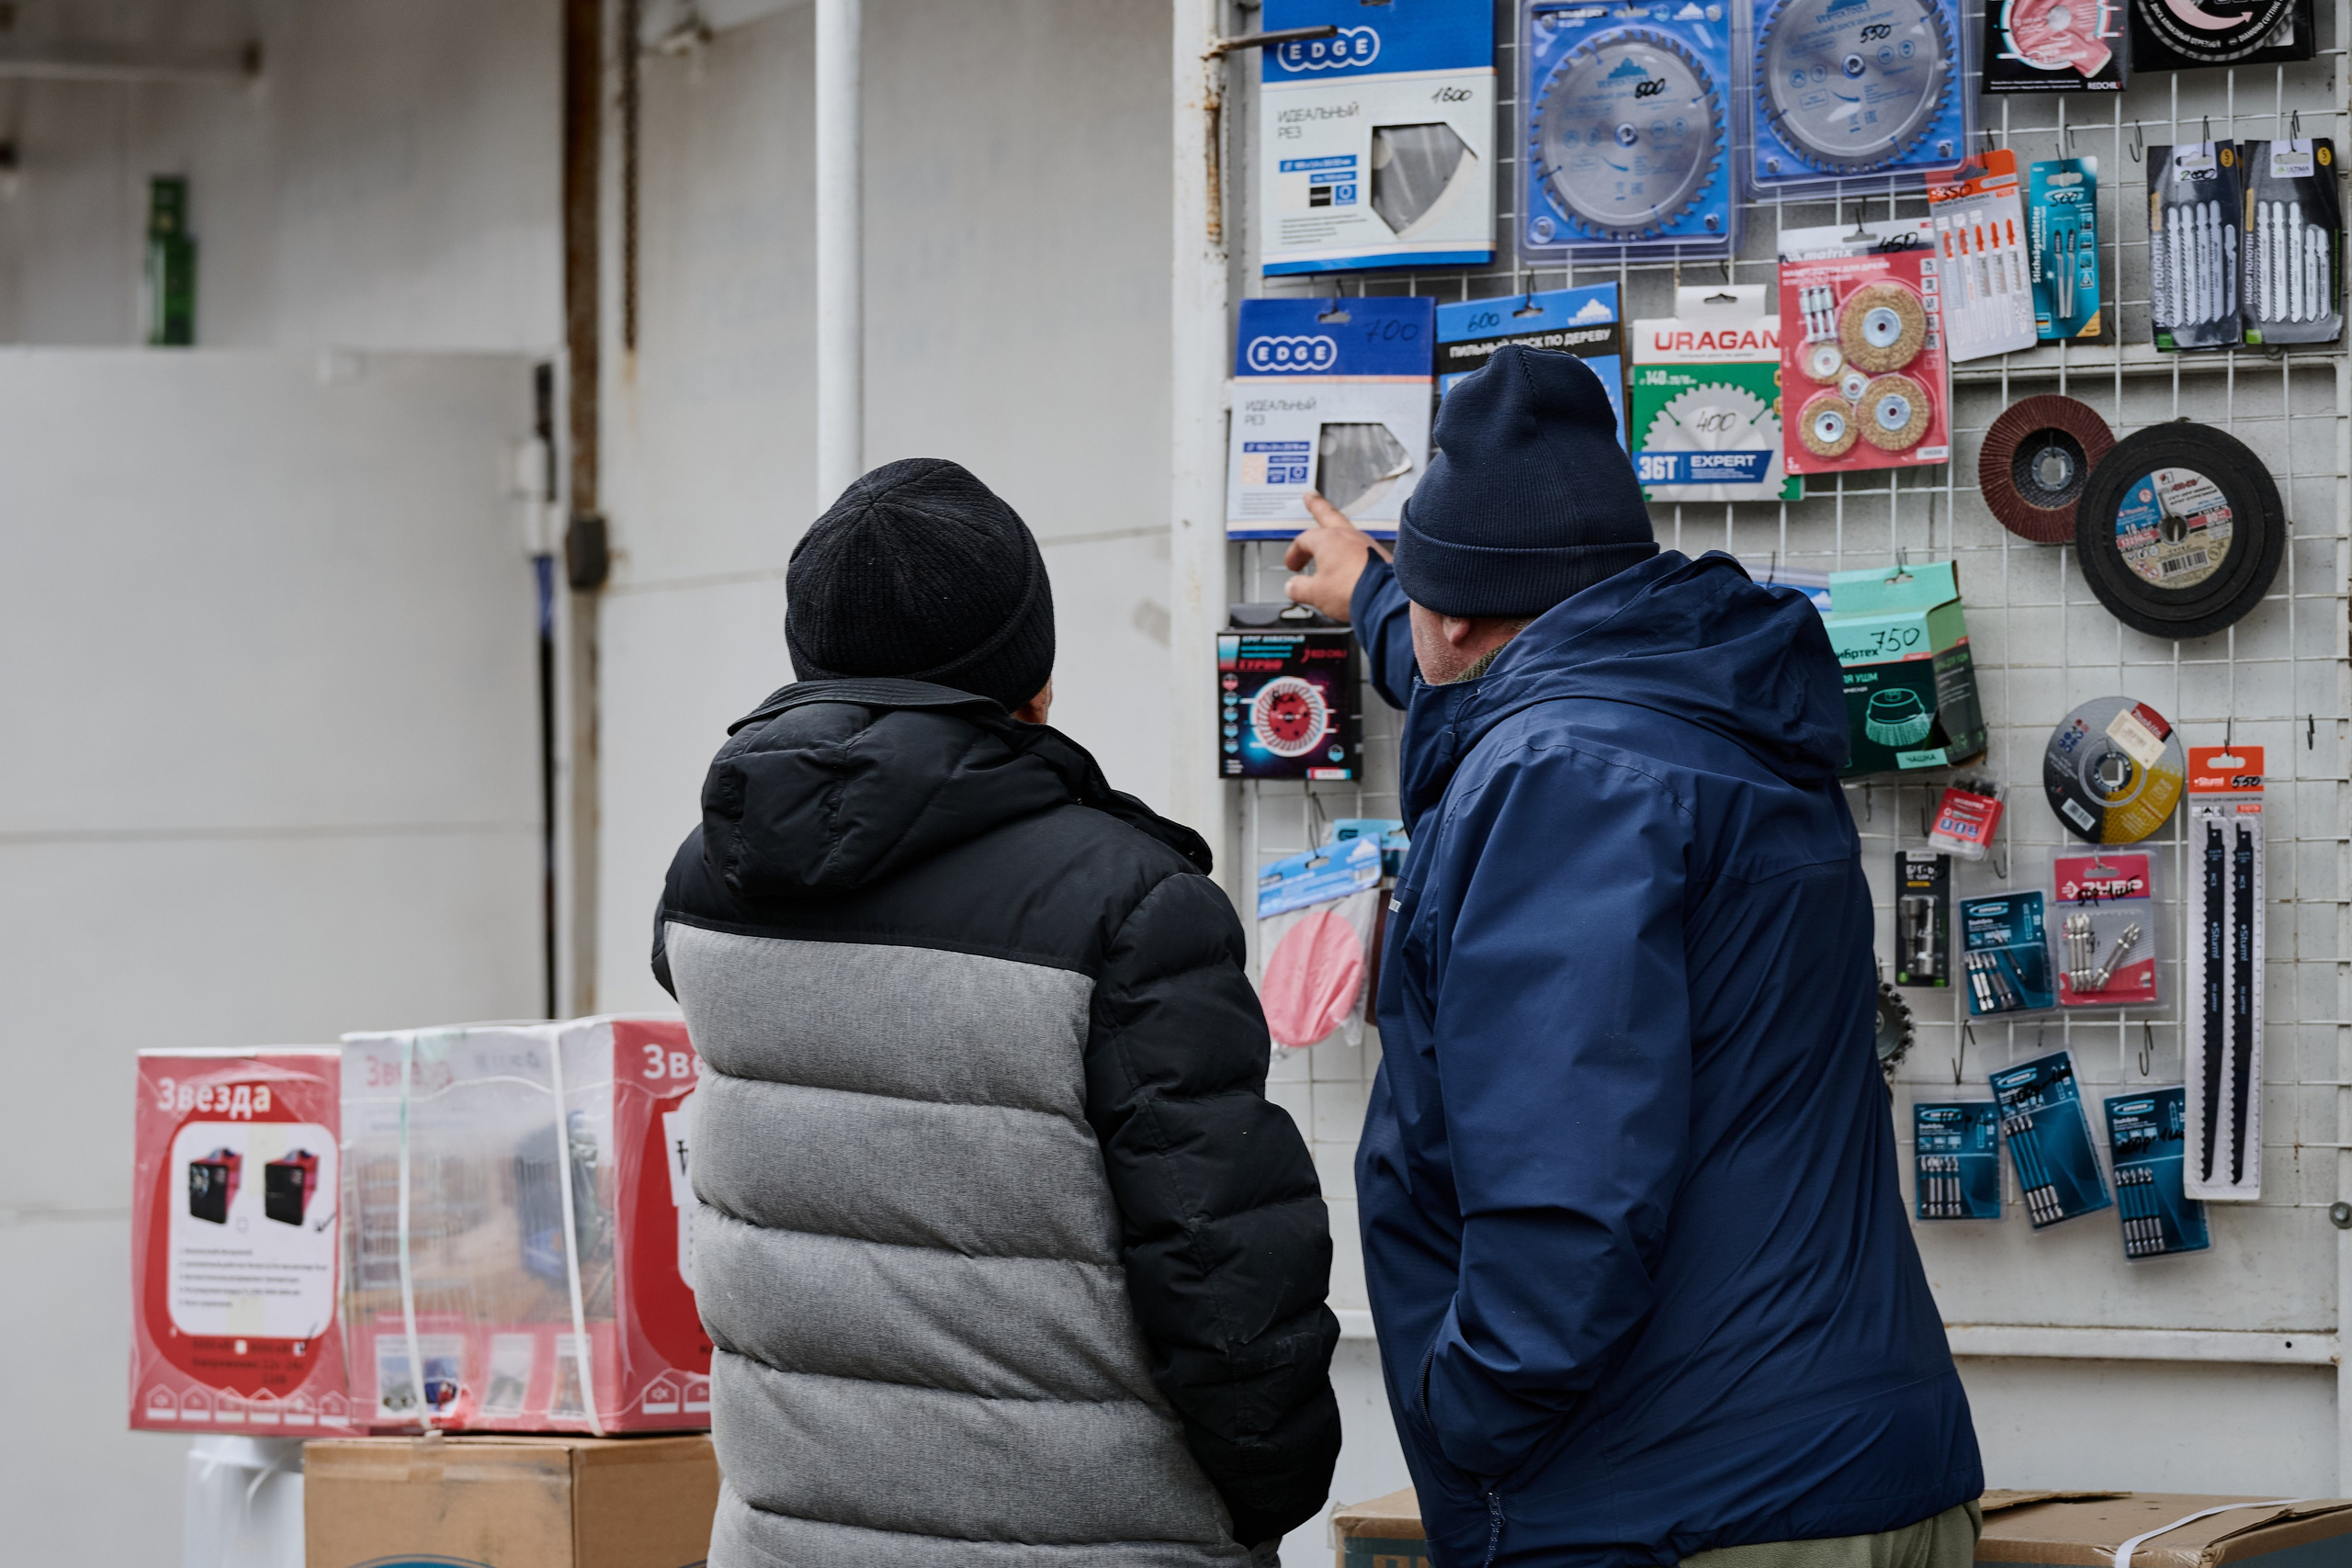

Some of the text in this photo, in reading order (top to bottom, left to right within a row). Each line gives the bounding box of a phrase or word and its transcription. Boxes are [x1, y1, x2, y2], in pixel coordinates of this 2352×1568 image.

[2238, 1, 2282, 43] DIAMOND CUTTING
[1289, 38, 1369, 61] EDGE
[1278, 102, 1360, 123] ИДЕАЛЬНЫЙ
[1278, 127, 1302, 139] РЕЗ
[1878, 232, 1919, 250] 450
[2030, 206, 2041, 284] Stichsägeblätter
[1803, 249, 1854, 261] matrix
[2153, 235, 2165, 288] ПОЛОТЕН
[2245, 233, 2254, 274] ПОЛОТЕН
[2245, 275, 2254, 305] НАБОР
[2154, 289, 2165, 328] НАБОР
[1364, 320, 1419, 343] 700
[1467, 312, 1500, 333] 600
[1544, 334, 1564, 347] ПО
[1564, 329, 1611, 346] ДЕРЕВУ
[1655, 331, 1781, 351] URAGAN
[1257, 345, 1327, 361] EDGE
[1245, 396, 1317, 412] ИДЕАЛЬНЫЙ
[1244, 414, 1265, 426] РЕЗ
[1696, 412, 1736, 433] 400
[1638, 456, 1679, 480] 36T
[1690, 455, 1757, 468] EXPERT
[1870, 627, 1920, 652] 750
[1836, 647, 1880, 660] ибртех
[1855, 672, 1879, 683] УШМ
[2232, 774, 2261, 789] 550
[2211, 927, 2220, 960] Sturm!
[2240, 930, 2248, 962] Sturm!
[156, 1077, 273, 1120] Звезда
